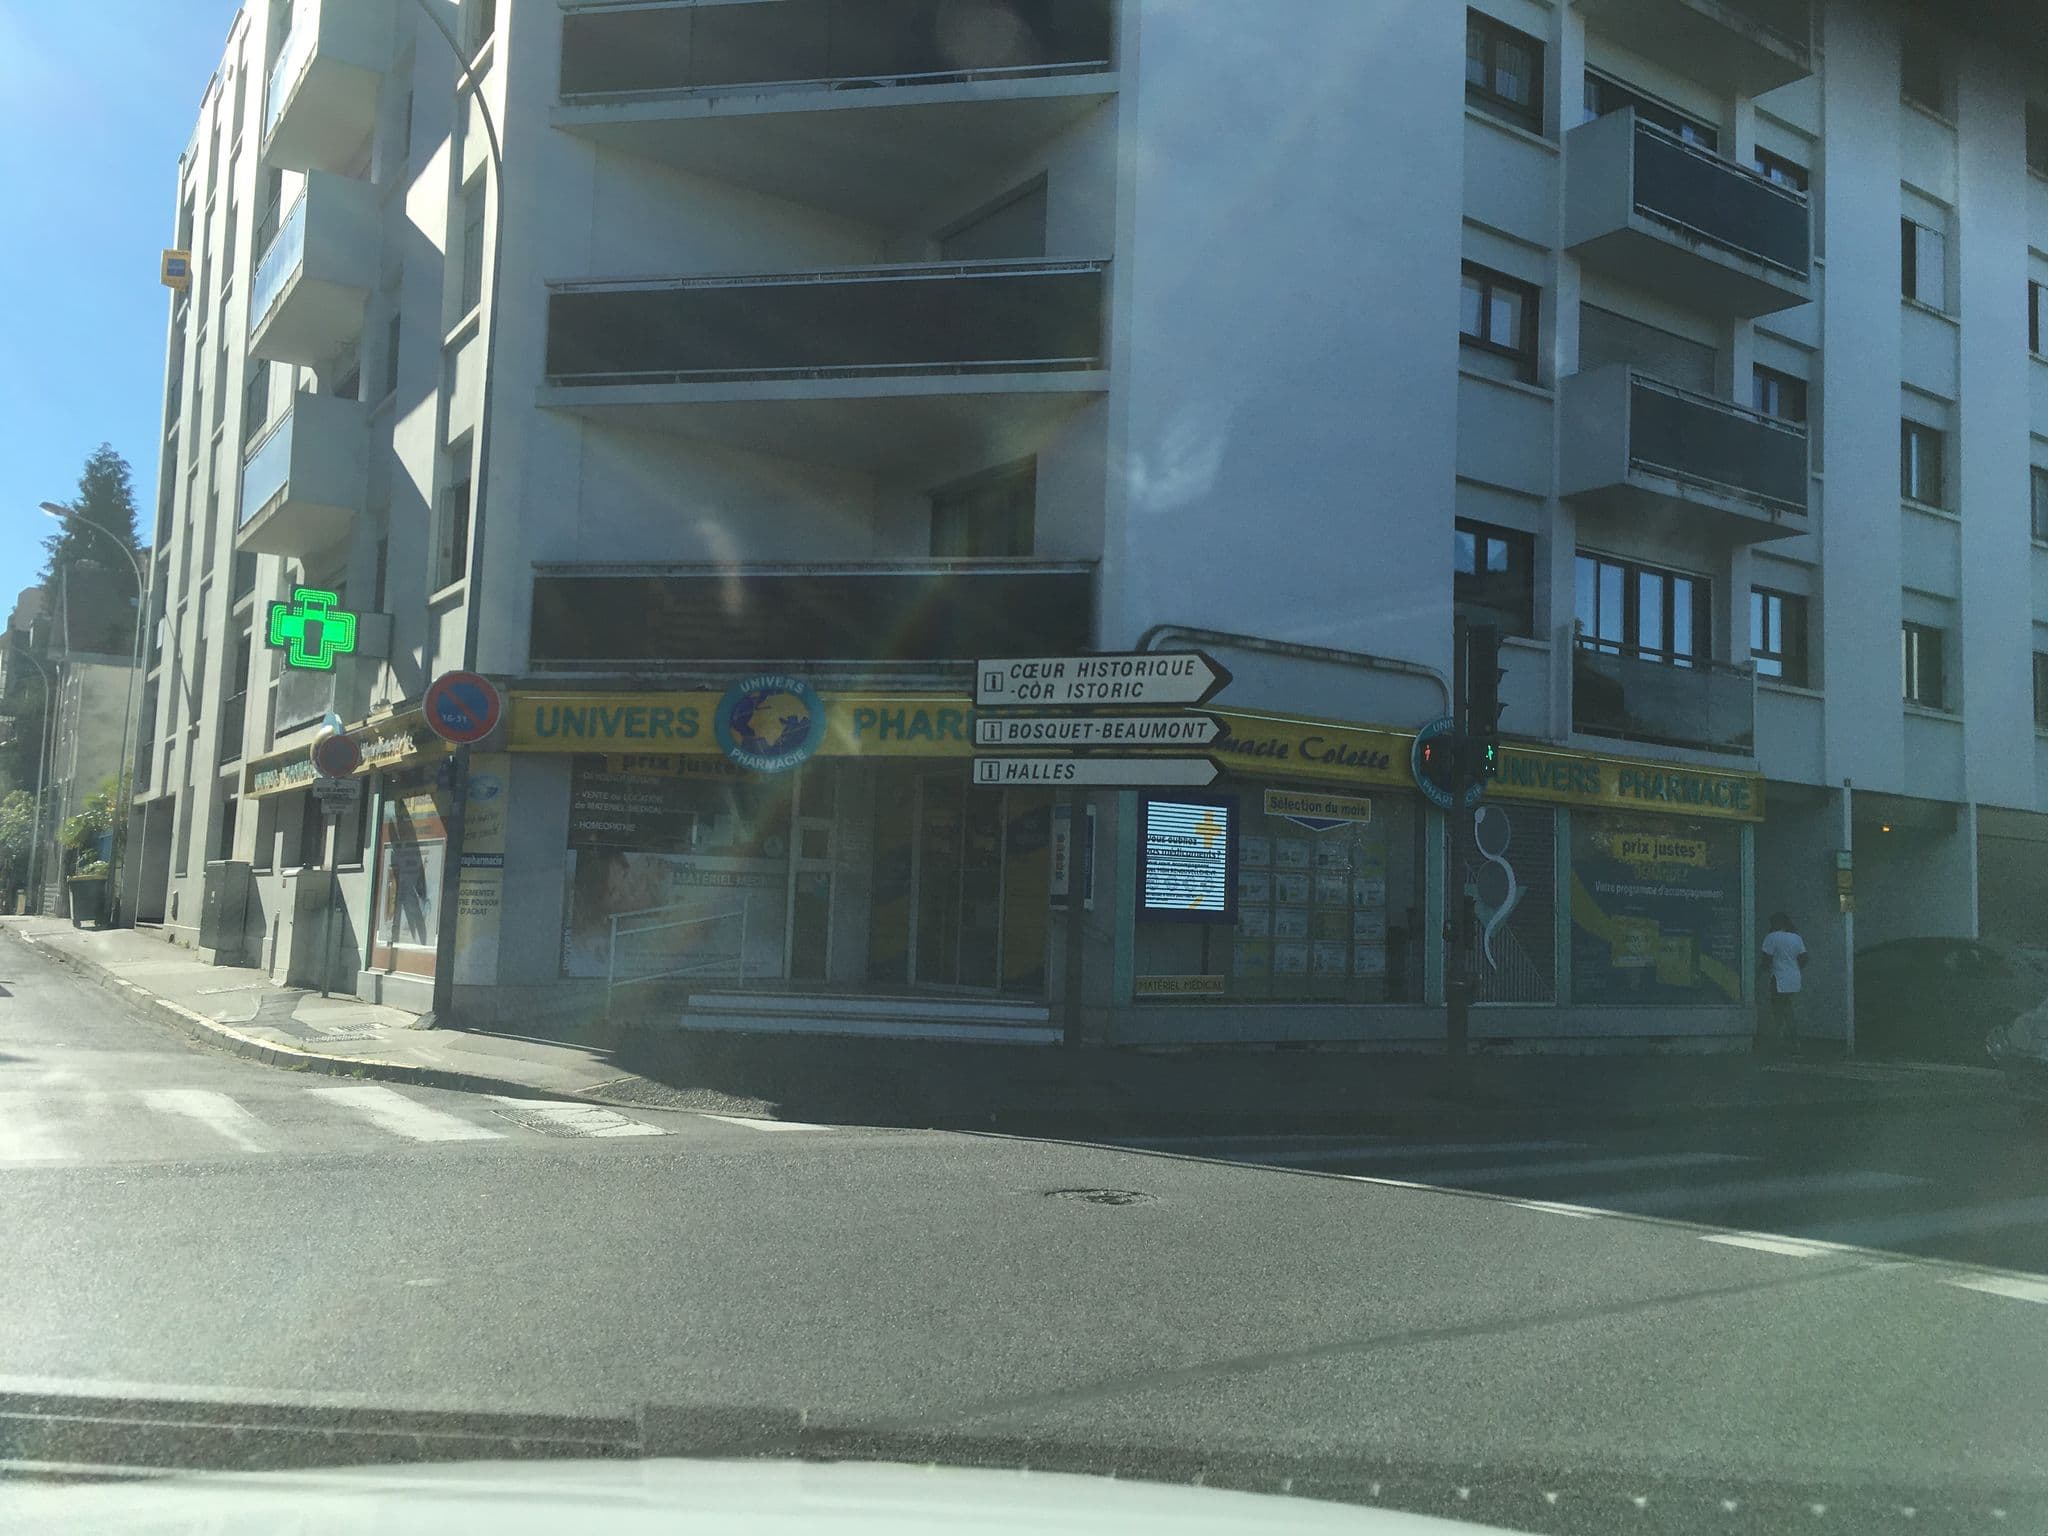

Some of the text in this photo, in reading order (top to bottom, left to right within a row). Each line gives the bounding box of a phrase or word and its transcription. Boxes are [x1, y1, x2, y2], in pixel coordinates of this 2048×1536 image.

[1077, 660, 1196, 678] HISTORIQUE
[740, 676, 805, 693] UNIVERS
[1067, 683, 1144, 698] ISTORIC
[536, 706, 700, 738] UNIVERS
[1009, 721, 1208, 740] BOSQUET-BEAUMONT
[730, 747, 807, 770] PHARMACIE
[1299, 736, 1390, 769] Colette
[1006, 763, 1076, 780] HALLES
[1617, 766, 1752, 811] PHARMACIE
[1622, 838, 1649, 856] prix
